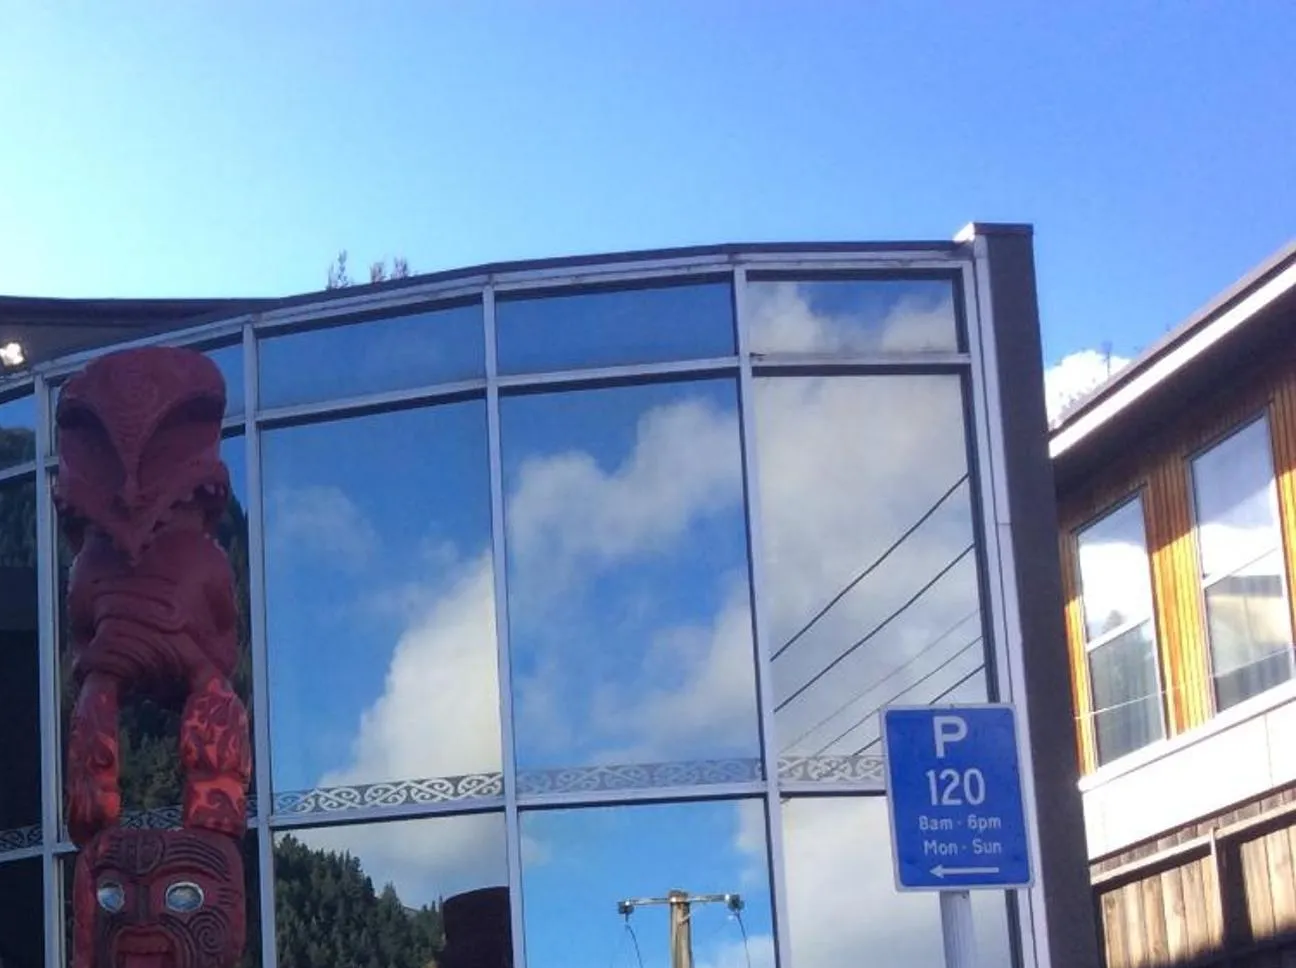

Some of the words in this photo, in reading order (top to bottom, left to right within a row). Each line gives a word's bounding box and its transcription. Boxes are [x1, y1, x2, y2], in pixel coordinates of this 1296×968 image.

[932, 715, 969, 759] P
[925, 768, 986, 806] 120
[918, 815, 953, 831] 8am
[967, 814, 1002, 832] 6pm
[923, 839, 959, 856] Mon
[972, 838, 1003, 855] Sun
